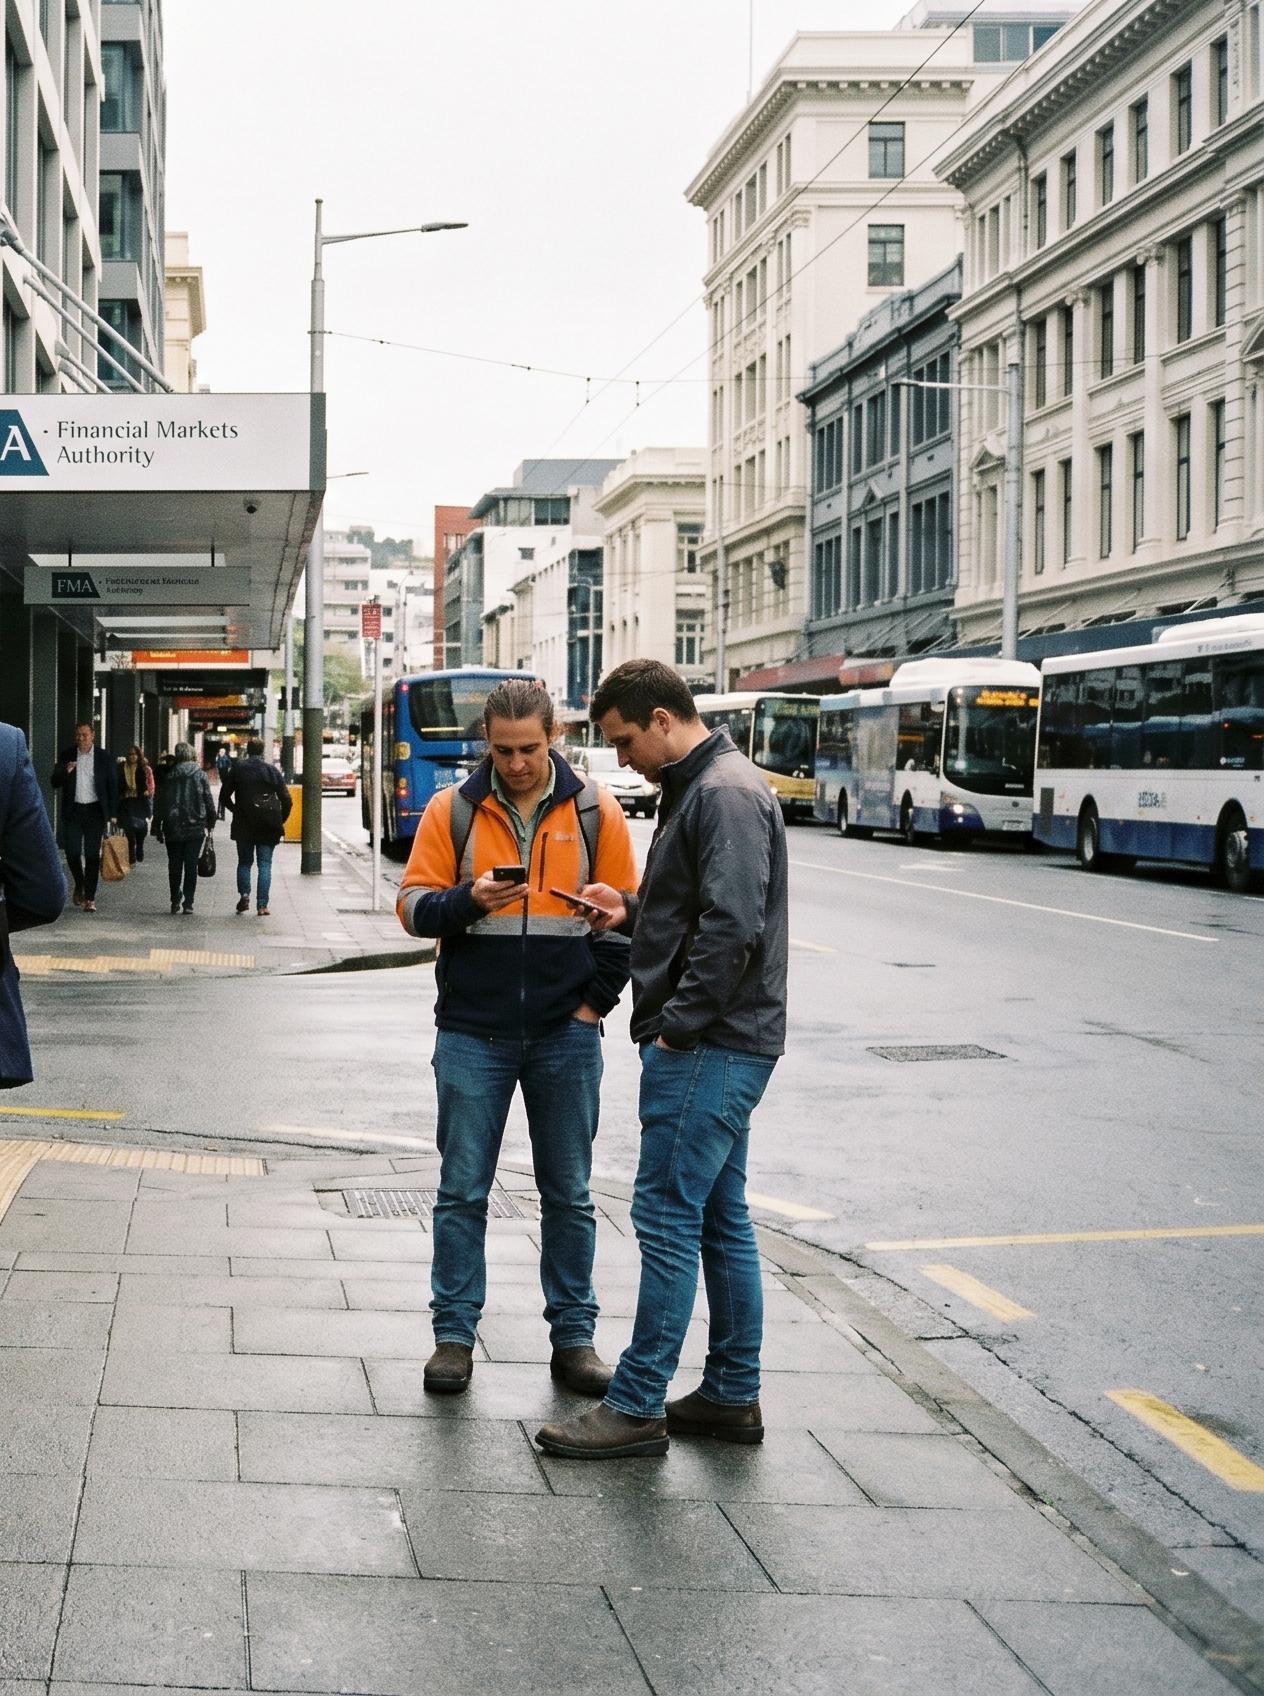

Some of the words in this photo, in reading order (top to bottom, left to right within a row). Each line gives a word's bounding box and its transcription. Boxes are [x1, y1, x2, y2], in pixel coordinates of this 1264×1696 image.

[57, 420, 148, 439] Financial
[156, 420, 239, 439] Markets
[57, 445, 155, 468] Authority
[57, 579, 93, 593] FMA
